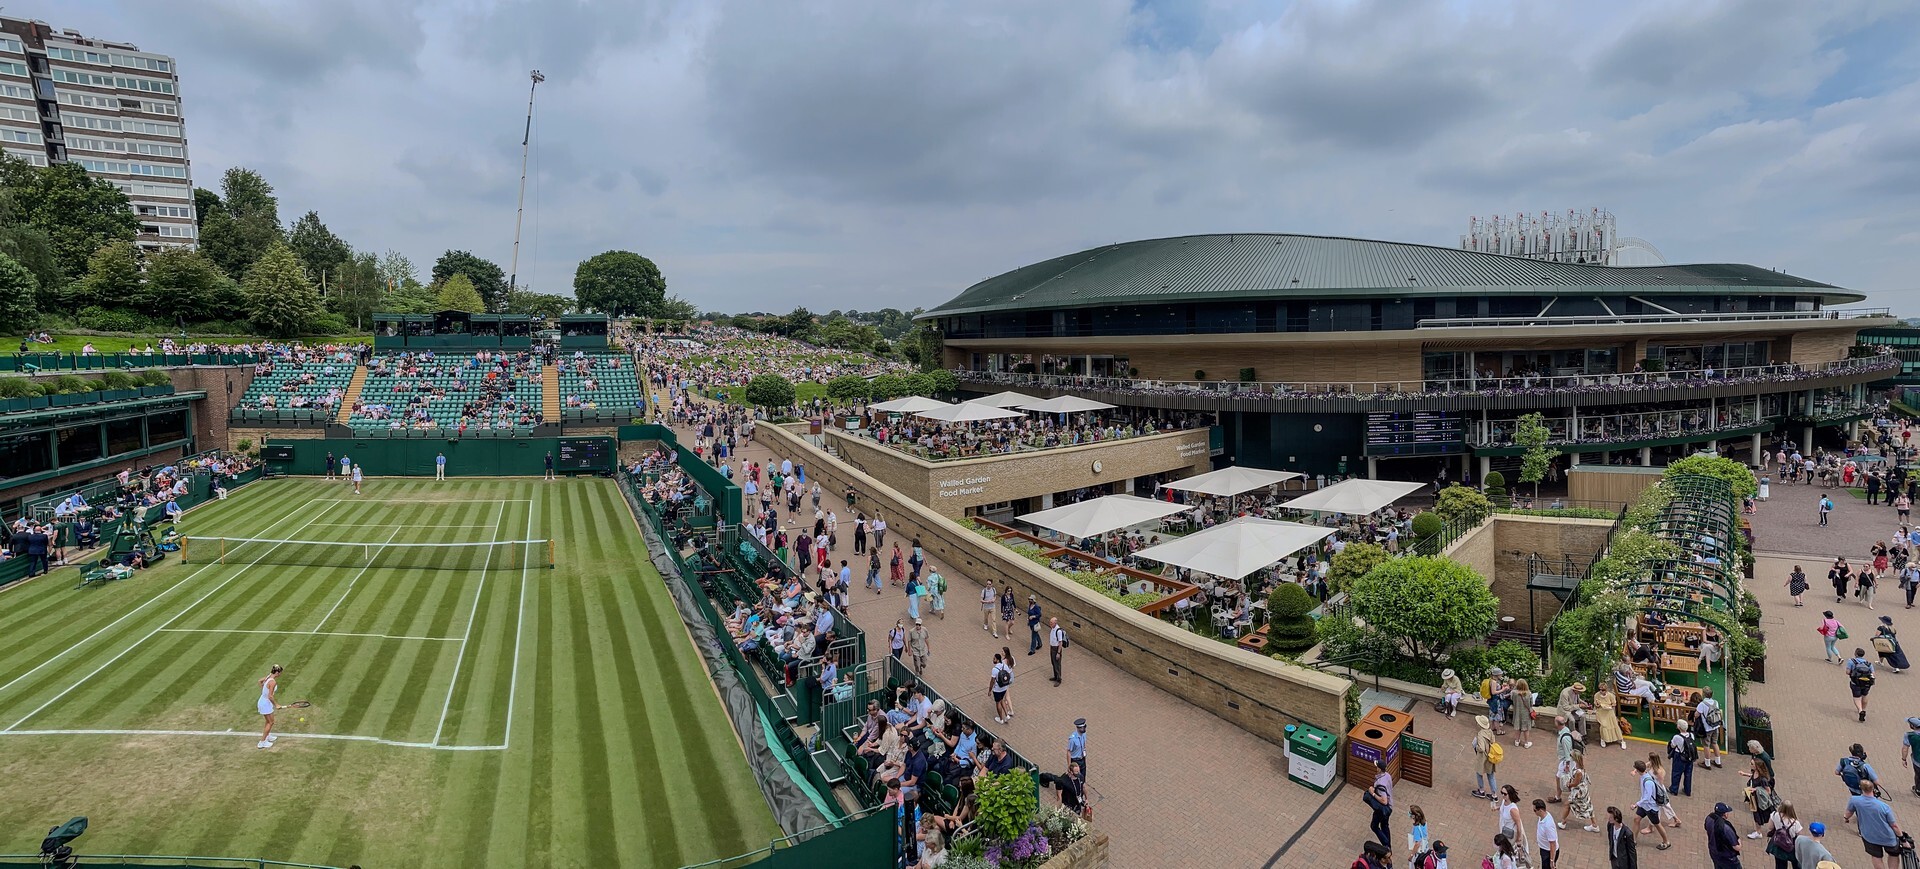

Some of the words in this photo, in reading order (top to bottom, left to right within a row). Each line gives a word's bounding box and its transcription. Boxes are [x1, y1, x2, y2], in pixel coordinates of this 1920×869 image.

[1176, 443, 1191, 452] Walled
[1191, 441, 1206, 449] Garden
[1180, 450, 1191, 458] Food
[939, 479, 964, 488] Walled
[965, 475, 991, 485] Garden
[939, 488, 958, 498] Food
[959, 486, 983, 495] Market
